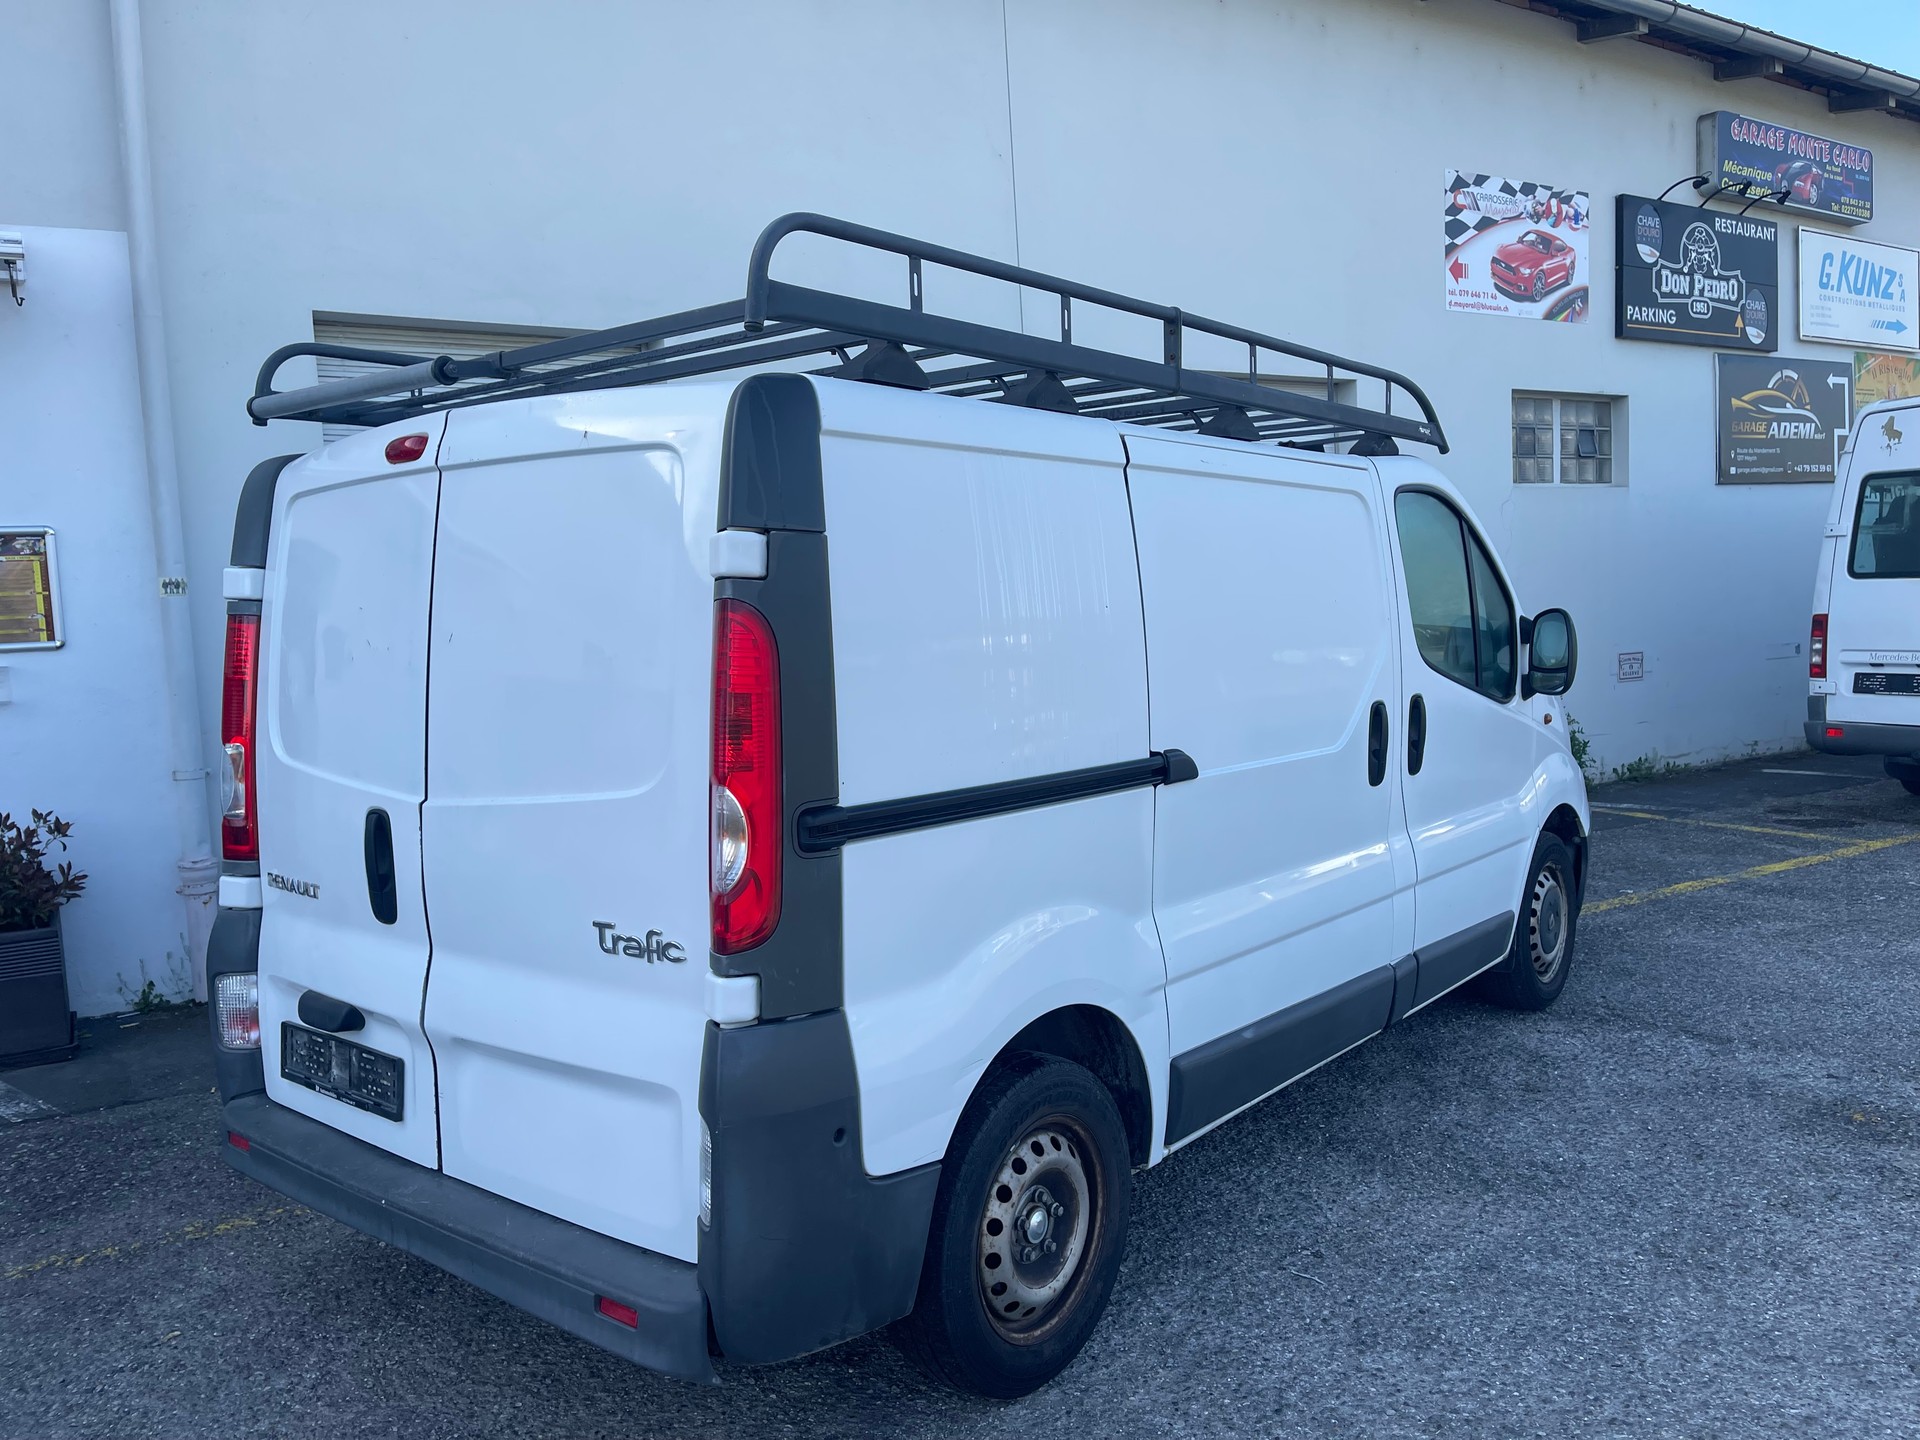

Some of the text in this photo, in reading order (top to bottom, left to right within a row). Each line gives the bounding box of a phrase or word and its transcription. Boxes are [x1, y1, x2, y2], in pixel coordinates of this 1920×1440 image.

[1731, 118, 1871, 172] GARAGE MONTE CARLO
[1723, 160, 1773, 181] Mécanique
[1476, 193, 1518, 207] CARROSSERIE
[1637, 215, 1660, 228] CHAVE
[1715, 217, 1775, 241] RESTAURANT
[1471, 291, 1481, 299] 646
[1490, 292, 1498, 300] 46
[1819, 294, 1866, 308] CONSTRUCTIONS
[1448, 300, 1509, 311] d.mayoral@bluewin.ch
[1693, 301, 1708, 313] 1951
[1745, 300, 1766, 311] CHAVE
[1627, 305, 1677, 324] PARKING
[1731, 421, 1768, 432] GARAGE
[1767, 421, 1816, 439] ADEMI
[1794, 464, 1803, 472] +41
[1803, 464, 1810, 473] 79
[267, 872, 321, 900] RENAULT
[592, 919, 688, 964] Trafic
